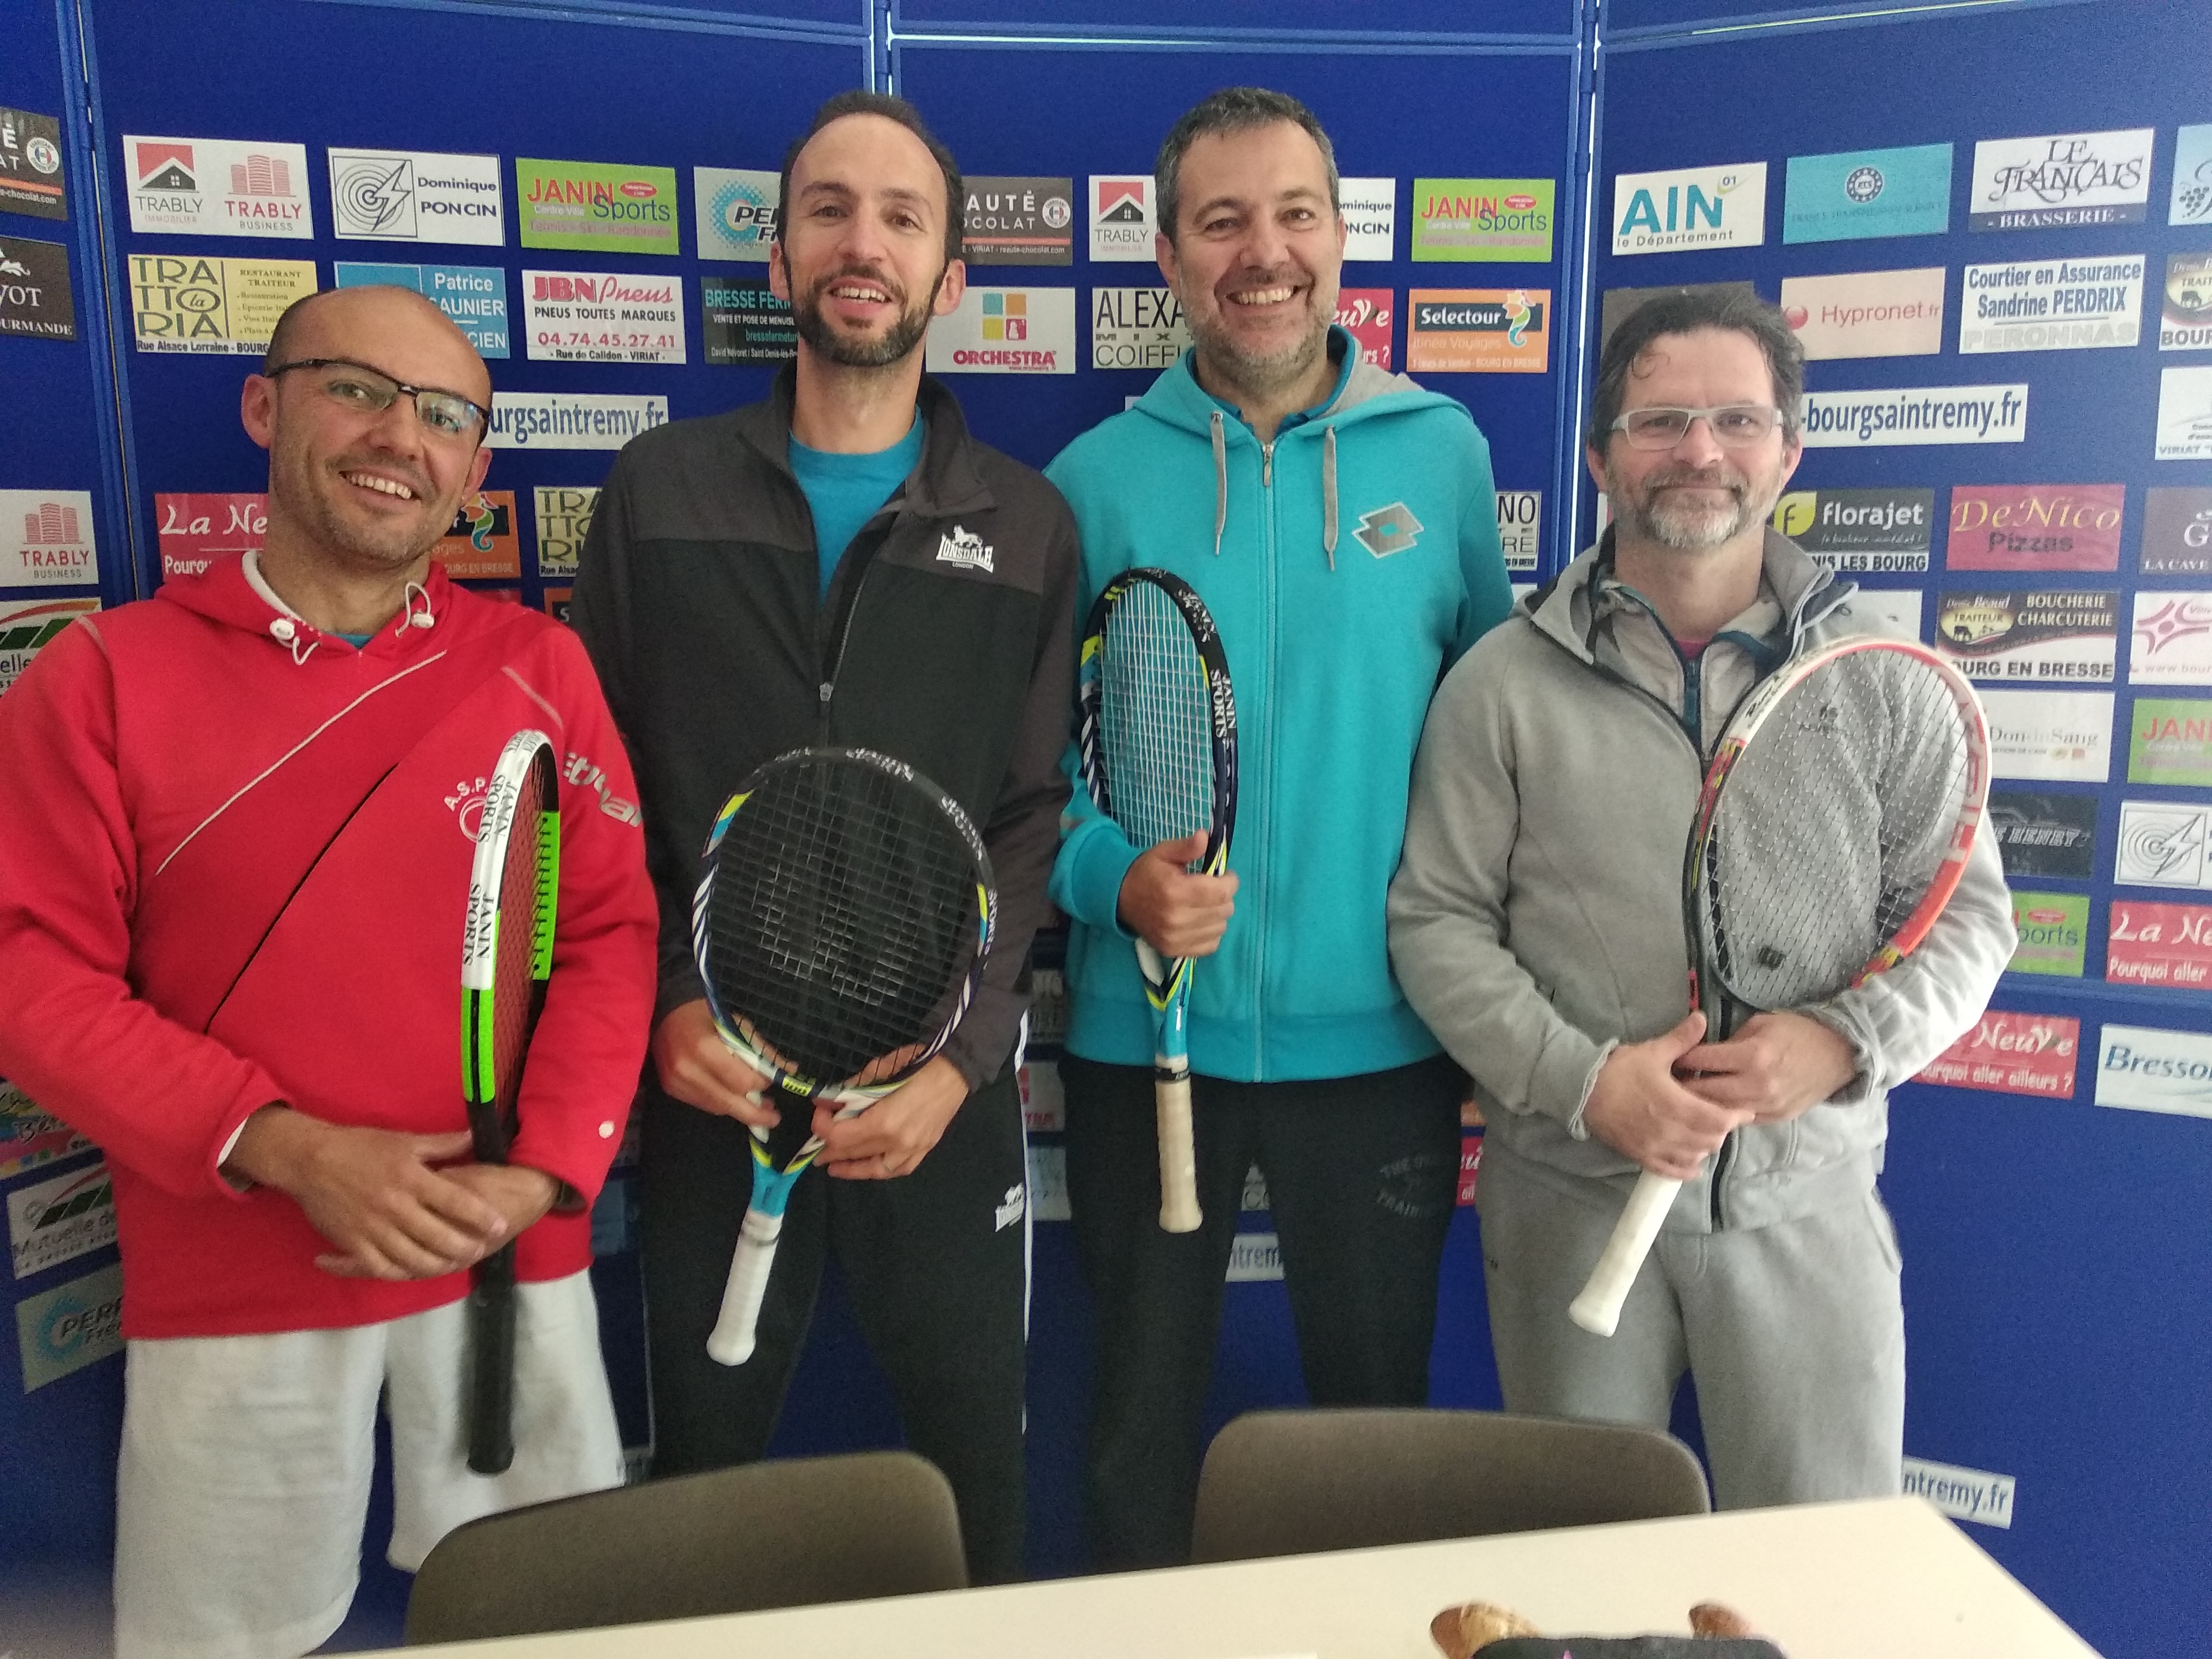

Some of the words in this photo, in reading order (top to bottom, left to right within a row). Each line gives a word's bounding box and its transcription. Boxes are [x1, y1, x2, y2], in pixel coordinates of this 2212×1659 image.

[2046, 140, 2088, 164] LE
[418, 177, 497, 193] Dominique
[1723, 176, 1736, 186] 01
[135, 196, 203, 213] TRABLY
[421, 201, 497, 217] PONCIN
[527, 179, 614, 206] JANIN
[593, 195, 671, 221] Sports
[225, 200, 302, 219] TRABLY
[1421, 196, 1498, 218] JANIN
[1478, 208, 1547, 232] Sports
[1618, 185, 1723, 236] AIN
[2000, 209, 2115, 228] BRASSERIE
[239, 221, 293, 231] BUSINESS
[1345, 222, 1390, 234] NCIN
[1094, 229, 1148, 243] TRABLY
[1617, 236, 1630, 247] le
[1636, 229, 1733, 247] Département
[132, 257, 219, 285] TRA
[239, 269, 301, 278] RESTAURANT
[1969, 266, 2032, 289] Courtier
[2035, 269, 2053, 285] en
[2058, 263, 2142, 284] Assurance
[248, 279, 296, 288] TRAITEUR
[434, 272, 493, 292] Patrice
[532, 276, 597, 303] JBN
[598, 276, 673, 304] Pneus
[705, 289, 756, 309] BRESSE
[1977, 291, 2048, 319] Sandrine
[2052, 286, 2127, 315] PERDRIX
[534, 307, 571, 319] PNEUS
[576, 308, 615, 320] TOUTES
[621, 309, 676, 322] MARQUES
[713, 314, 733, 324] VENTE
[734, 314, 742, 324] ET
[743, 315, 758, 325] POSE
[760, 316, 768, 325] DE
[1421, 307, 1501, 325] Selectour
[1821, 301, 1941, 328] Hypronet.fr
[137, 311, 222, 338] RIA
[538, 332, 675, 348] 04.74.45.27.41
[1964, 324, 2137, 350] PERONNAS
[138, 340, 154, 351] Rue
[157, 341, 188, 352] Alsace
[191, 342, 229, 353] Lorraine
[556, 349, 573, 359] Rue
[575, 351, 587, 360] de
[629, 351, 660, 362] VIRIAT
[711, 347, 726, 357] David
[953, 350, 1056, 367] ORCHESTRA
[160, 504, 211, 535] La
[1822, 501, 1924, 531] florajet
[1989, 531, 2074, 552] Pizzas
[20, 550, 90, 567] TRABLY
[936, 532, 994, 572] LONSDALE
[952, 561, 974, 570] LONDON
[1840, 555, 1868, 570] LES
[1873, 555, 1927, 571] BOURG
[34, 569, 82, 579] BUSINESS
[2026, 593, 2107, 609] BOUCHERIE
[1954, 613, 2004, 623] TRAITEUR
[2018, 611, 2114, 627] CHARCUTERIE
[2007, 661, 2033, 676] EN
[2038, 662, 2114, 678] BRESSE
[462, 883, 481, 967] SPORTS
[476, 891, 495, 960] JANIN
[2110, 910, 2162, 942] La
[2110, 954, 2168, 984] Pourquoi
[2174, 962, 2207, 983] aller
[1973, 1063, 2004, 1084] aller
[2008, 1067, 2058, 1091] ailleurs
[2063, 1071, 2073, 1092] ?
